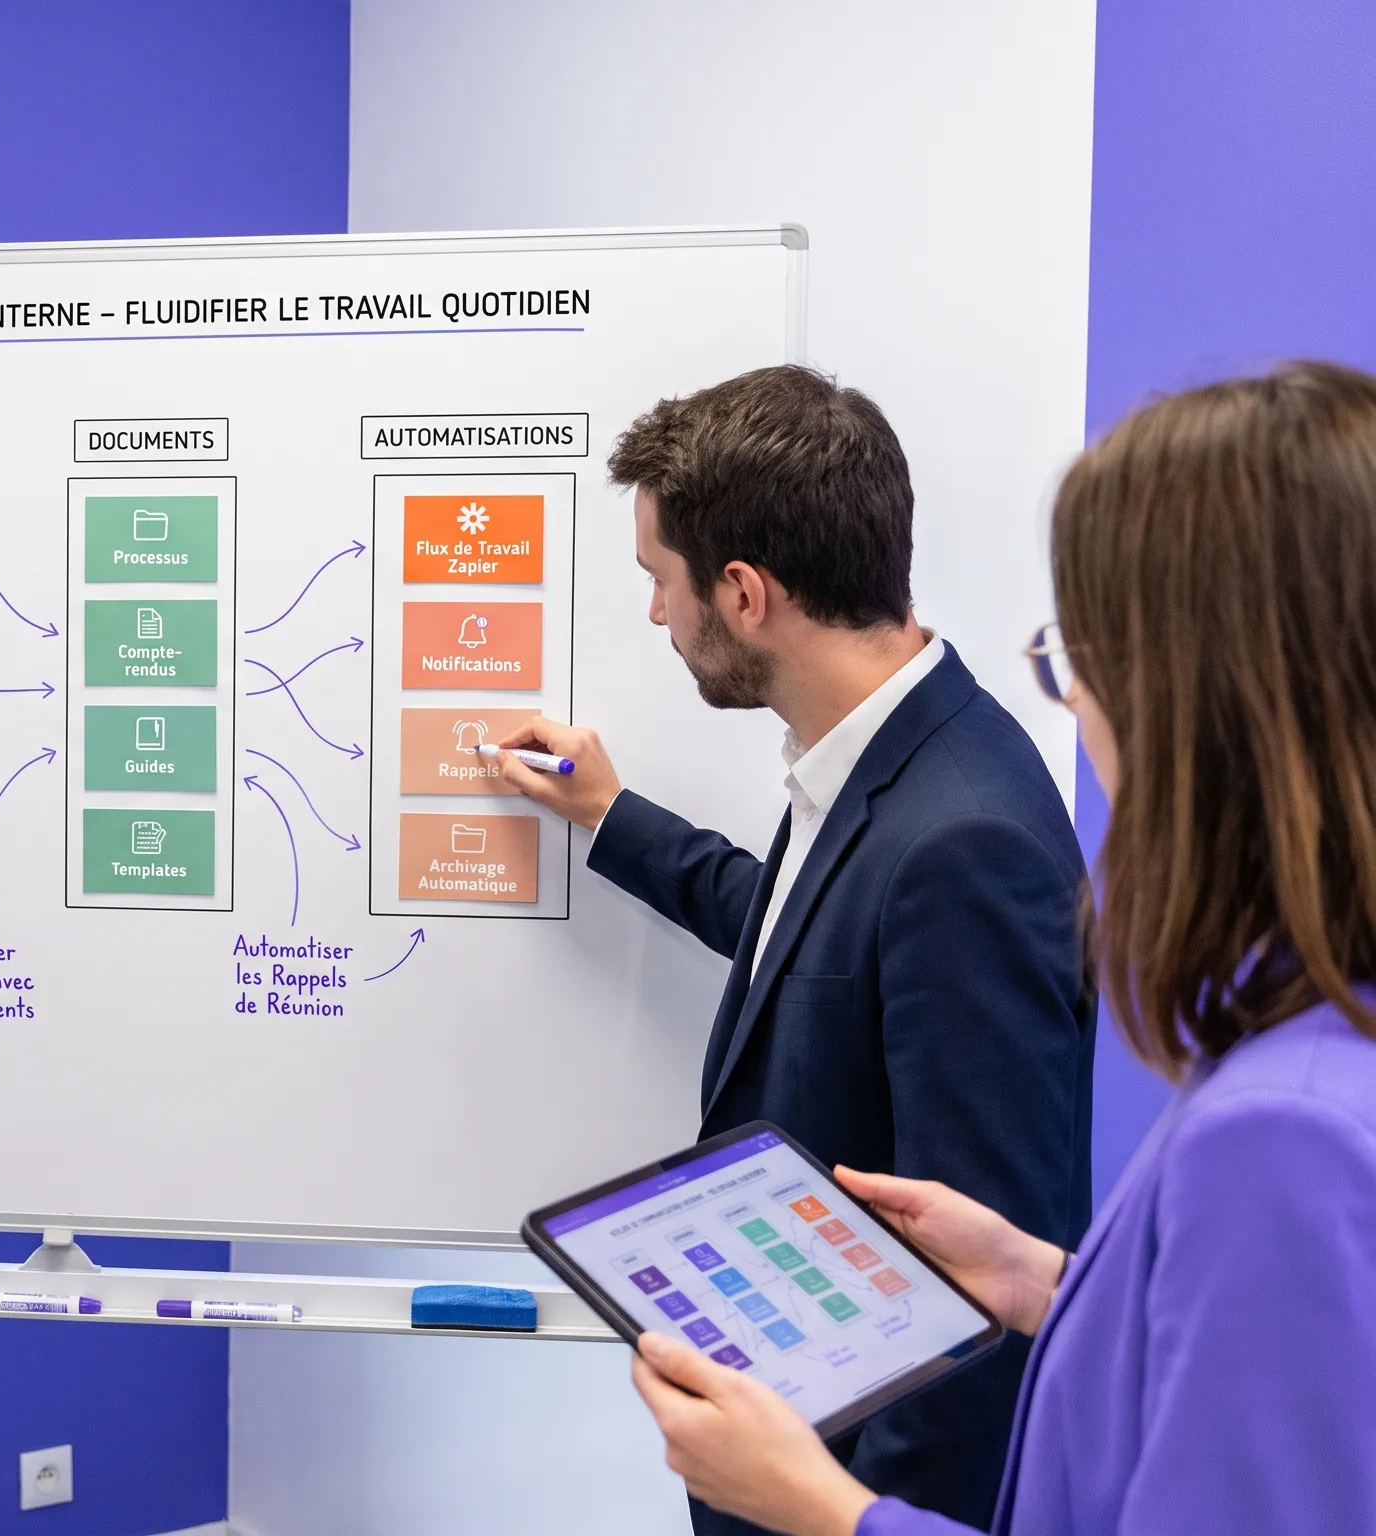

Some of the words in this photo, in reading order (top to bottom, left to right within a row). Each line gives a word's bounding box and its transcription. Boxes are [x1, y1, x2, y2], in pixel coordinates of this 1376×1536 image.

[126, 298, 267, 325] FLUIDIFIER
[279, 297, 309, 321] LE
[319, 294, 432, 320] TRAVAIL
[442, 289, 591, 322] QUOTIDIEN
[89, 431, 215, 450] DOCUMENTS
[374, 426, 573, 447] AUTOMATISATIONS
[416, 541, 448, 556] Flux
[454, 541, 472, 556] de
[478, 540, 530, 556] Travail
[113, 550, 189, 566] Processus
[448, 558, 499, 576] Zapier
[118, 645, 182, 662] Compte-
[125, 662, 176, 677] rendus
[422, 656, 521, 672] Notifications
[125, 759, 175, 774] Guides
[439, 763, 499, 781] Rappels
[112, 862, 186, 879] Templates
[429, 859, 506, 878] Archivage
[418, 877, 517, 895] Automatique
[233, 934, 353, 959] Automatiser
[236, 962, 262, 985] les
[272, 964, 346, 995] Rappels
[235, 992, 257, 1014] de
[268, 992, 344, 1016] Réunion
